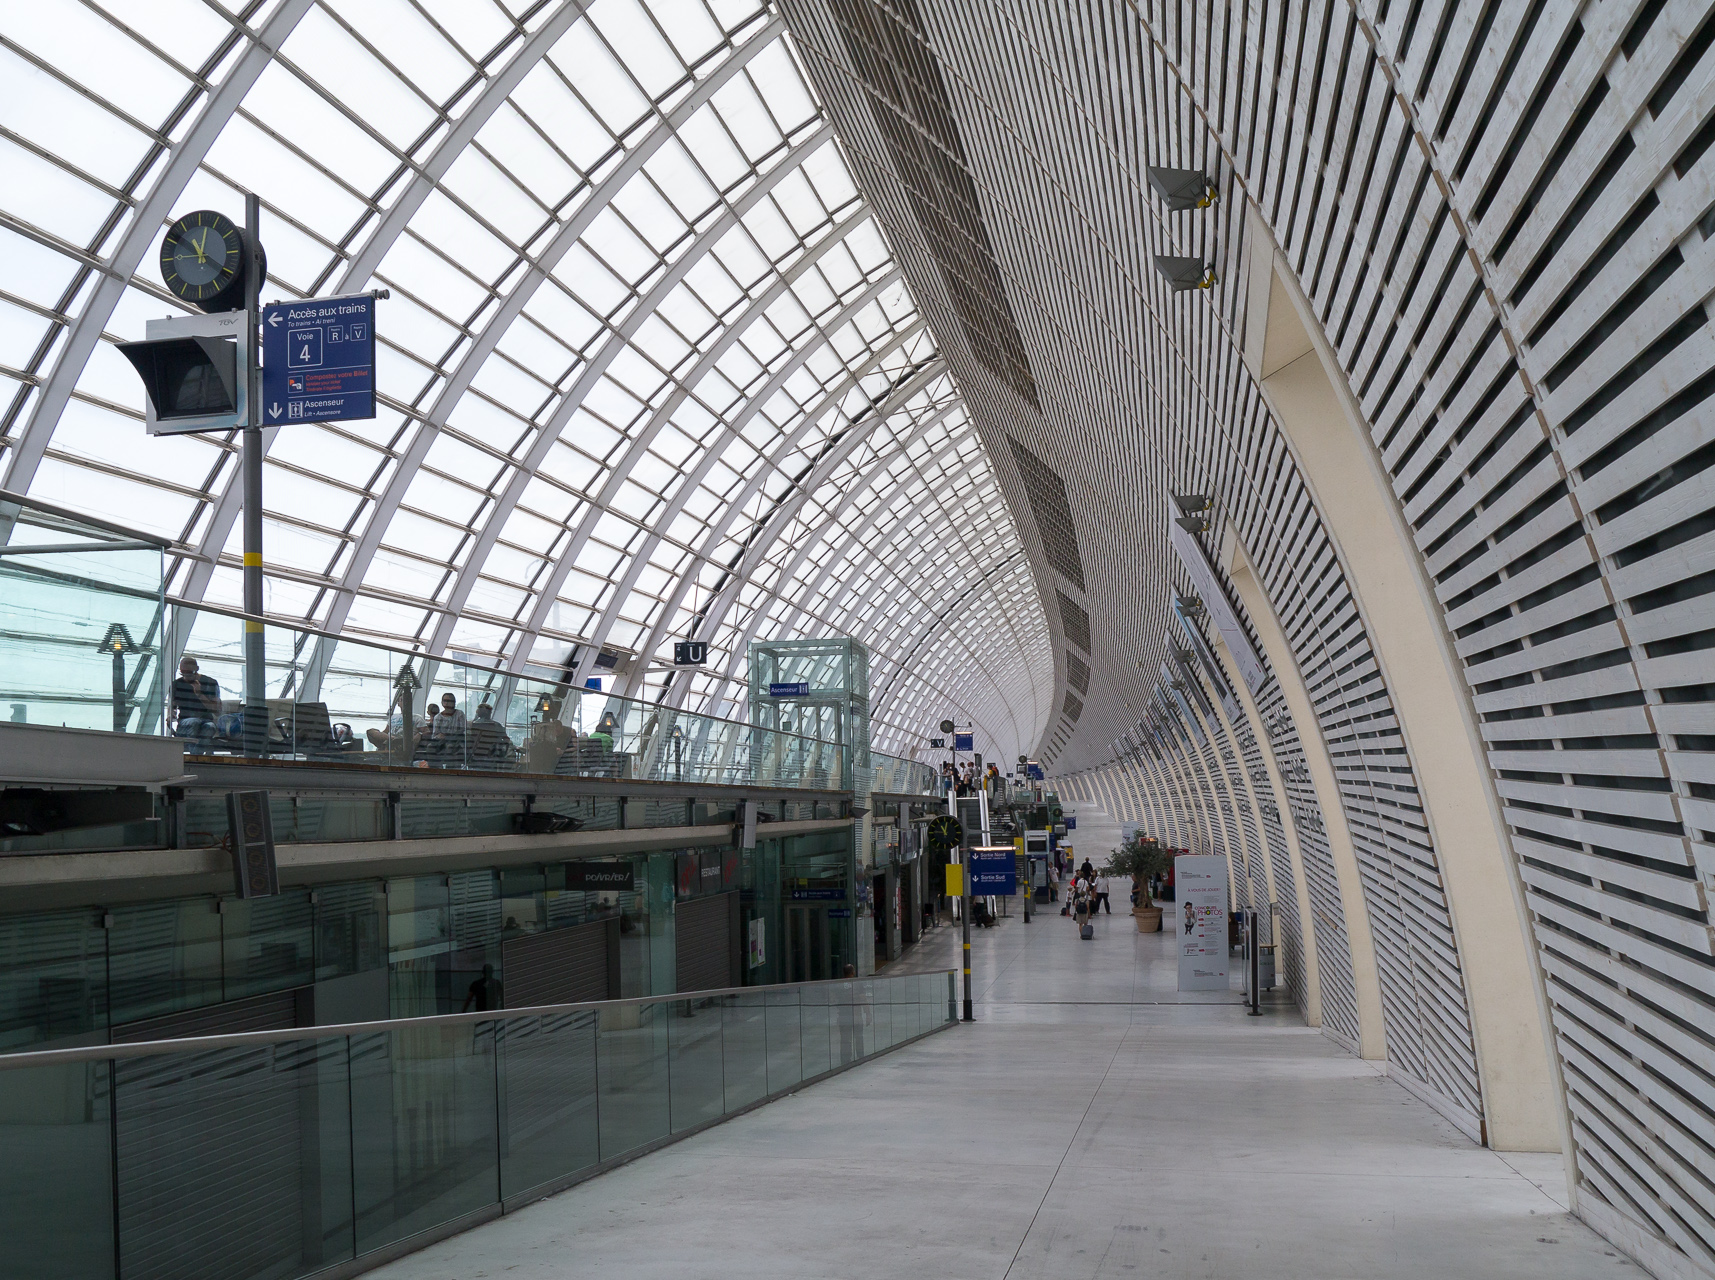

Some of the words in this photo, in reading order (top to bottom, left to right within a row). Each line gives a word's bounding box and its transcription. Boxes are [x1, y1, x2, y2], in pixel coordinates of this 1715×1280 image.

[288, 307, 317, 319] Accès
[319, 307, 337, 317] aux
[339, 303, 367, 314] trains
[297, 332, 314, 341] Voie
[332, 332, 339, 341] R
[354, 330, 362, 339] V
[299, 344, 311, 362] 4
[304, 399, 344, 408] Ascenseur
[689, 646, 702, 662] U
